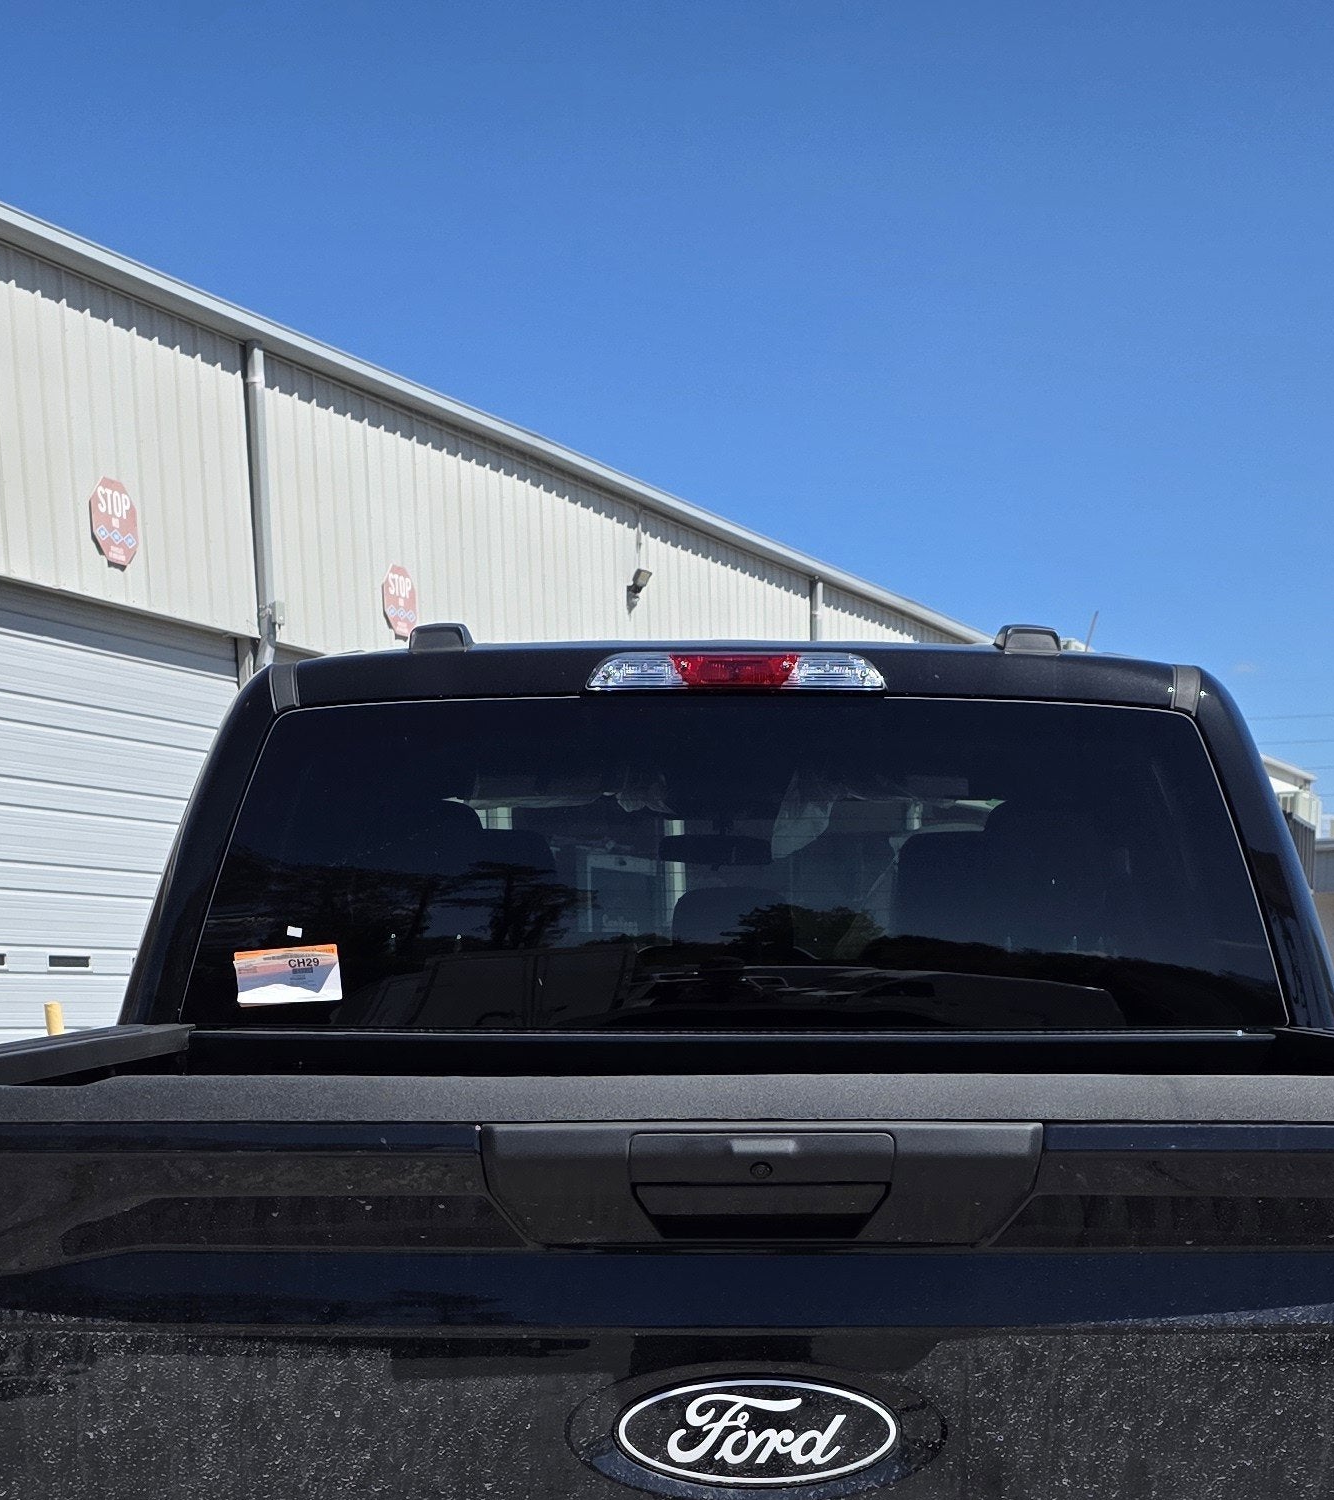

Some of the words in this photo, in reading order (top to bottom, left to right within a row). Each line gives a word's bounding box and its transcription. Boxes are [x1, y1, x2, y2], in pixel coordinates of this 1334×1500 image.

[97, 486, 130, 519] STOP
[389, 573, 411, 598] STOP
[288, 958, 319, 968] CH29
[667, 1393, 847, 1466] Ford
